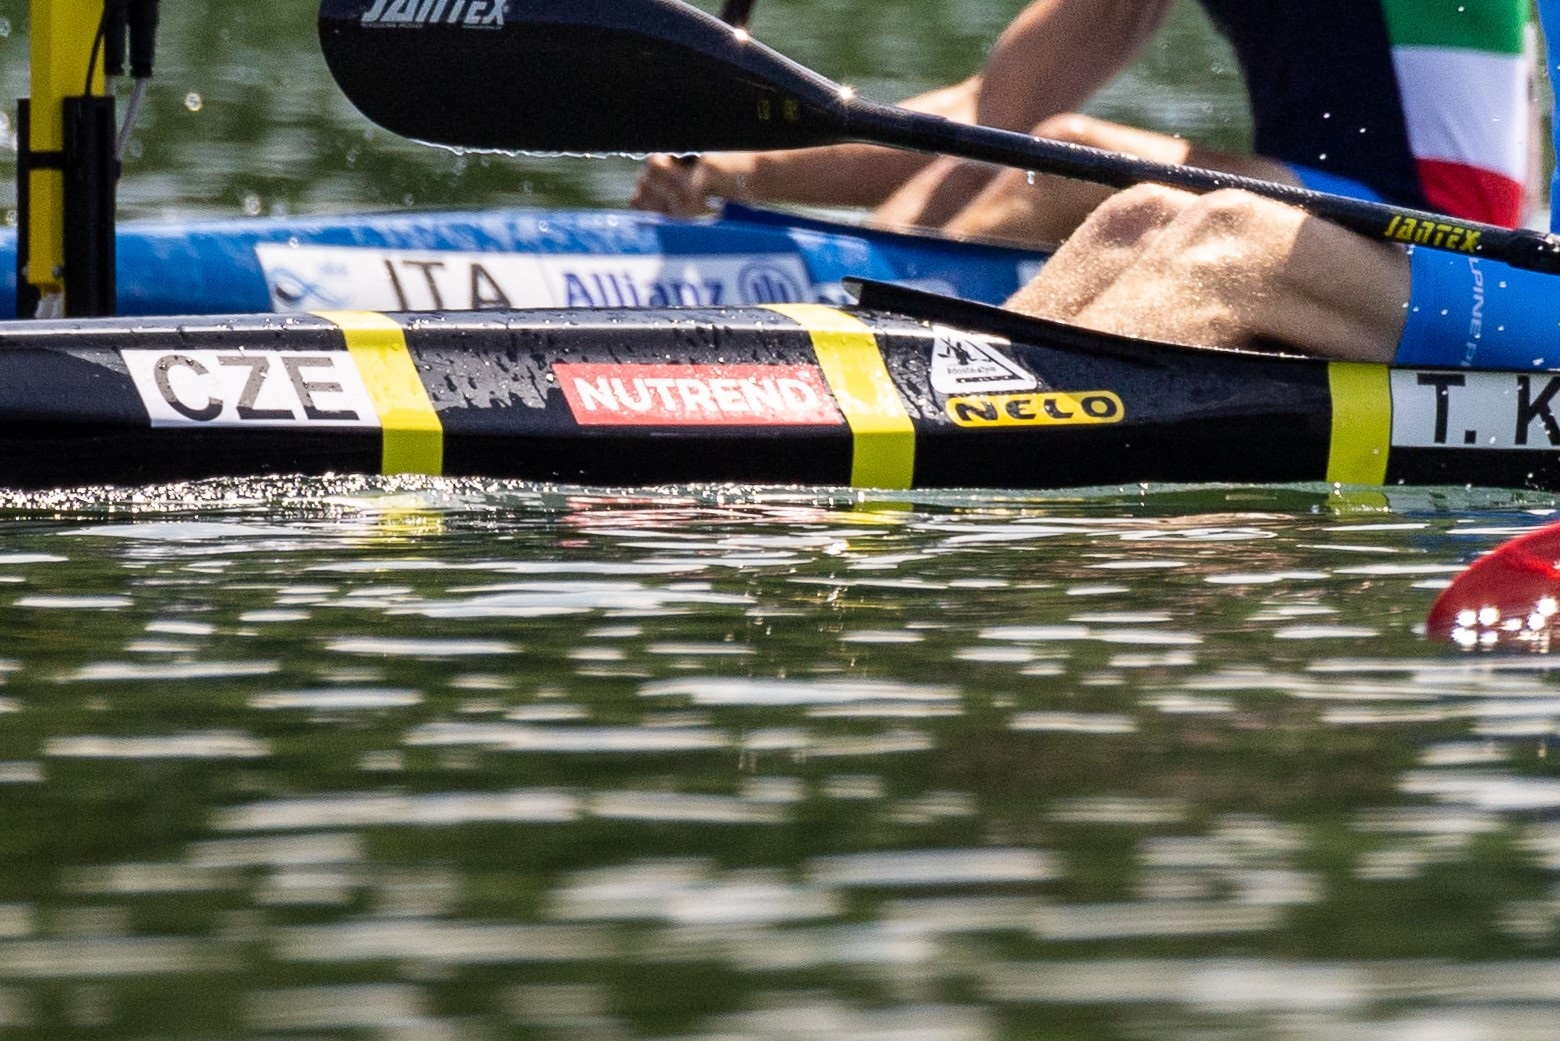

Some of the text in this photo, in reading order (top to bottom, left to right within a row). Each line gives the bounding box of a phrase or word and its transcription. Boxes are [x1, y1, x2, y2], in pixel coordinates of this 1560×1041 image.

[1384, 215, 1480, 252] JANTEX
[383, 258, 513, 309] ITA
[564, 266, 725, 308] Allianz
[154, 354, 361, 422] CZE
[572, 375, 818, 413] NUTREND
[955, 396, 1118, 422] NELO
[1416, 372, 1478, 445] T.
